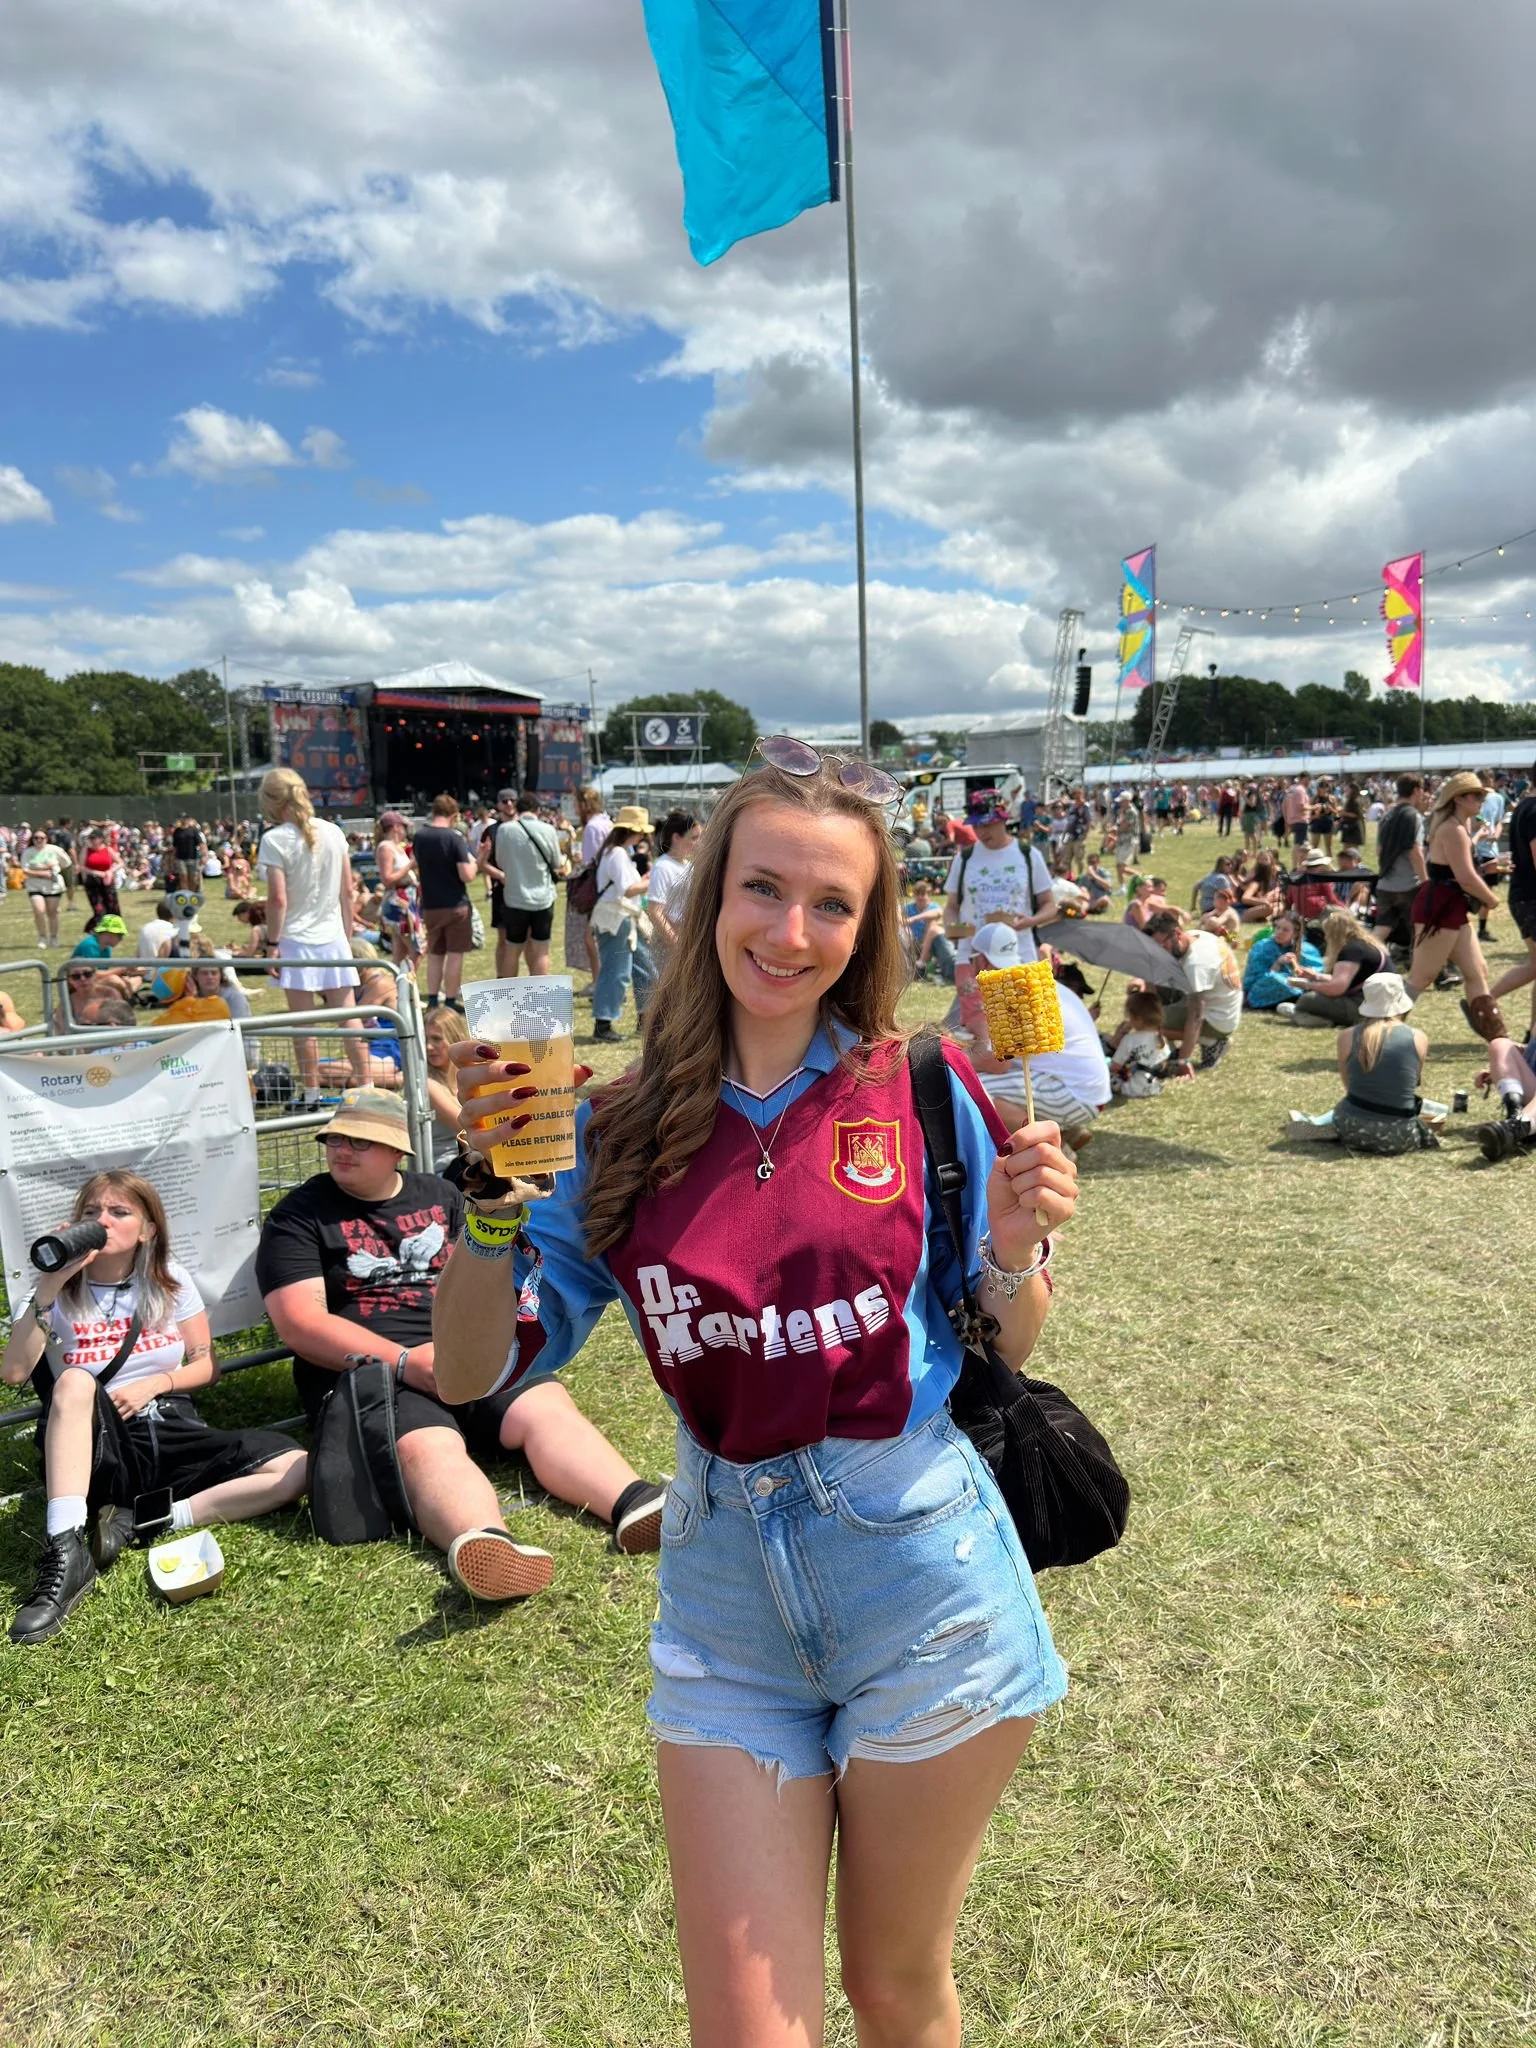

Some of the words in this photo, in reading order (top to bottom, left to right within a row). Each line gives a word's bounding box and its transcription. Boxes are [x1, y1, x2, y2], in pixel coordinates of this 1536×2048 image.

[1312, 740, 1334, 751] BAR
[40, 1074, 83, 1088] Rotary
[57, 1087, 85, 1096] District
[551, 1088, 562, 1096] ME
[502, 1137, 532, 1148] PLEASE
[534, 1133, 565, 1144] RETURN
[757, 1163, 772, 1180] G
[637, 1264, 702, 1315] Dr.
[647, 1284, 890, 1367] Martens
